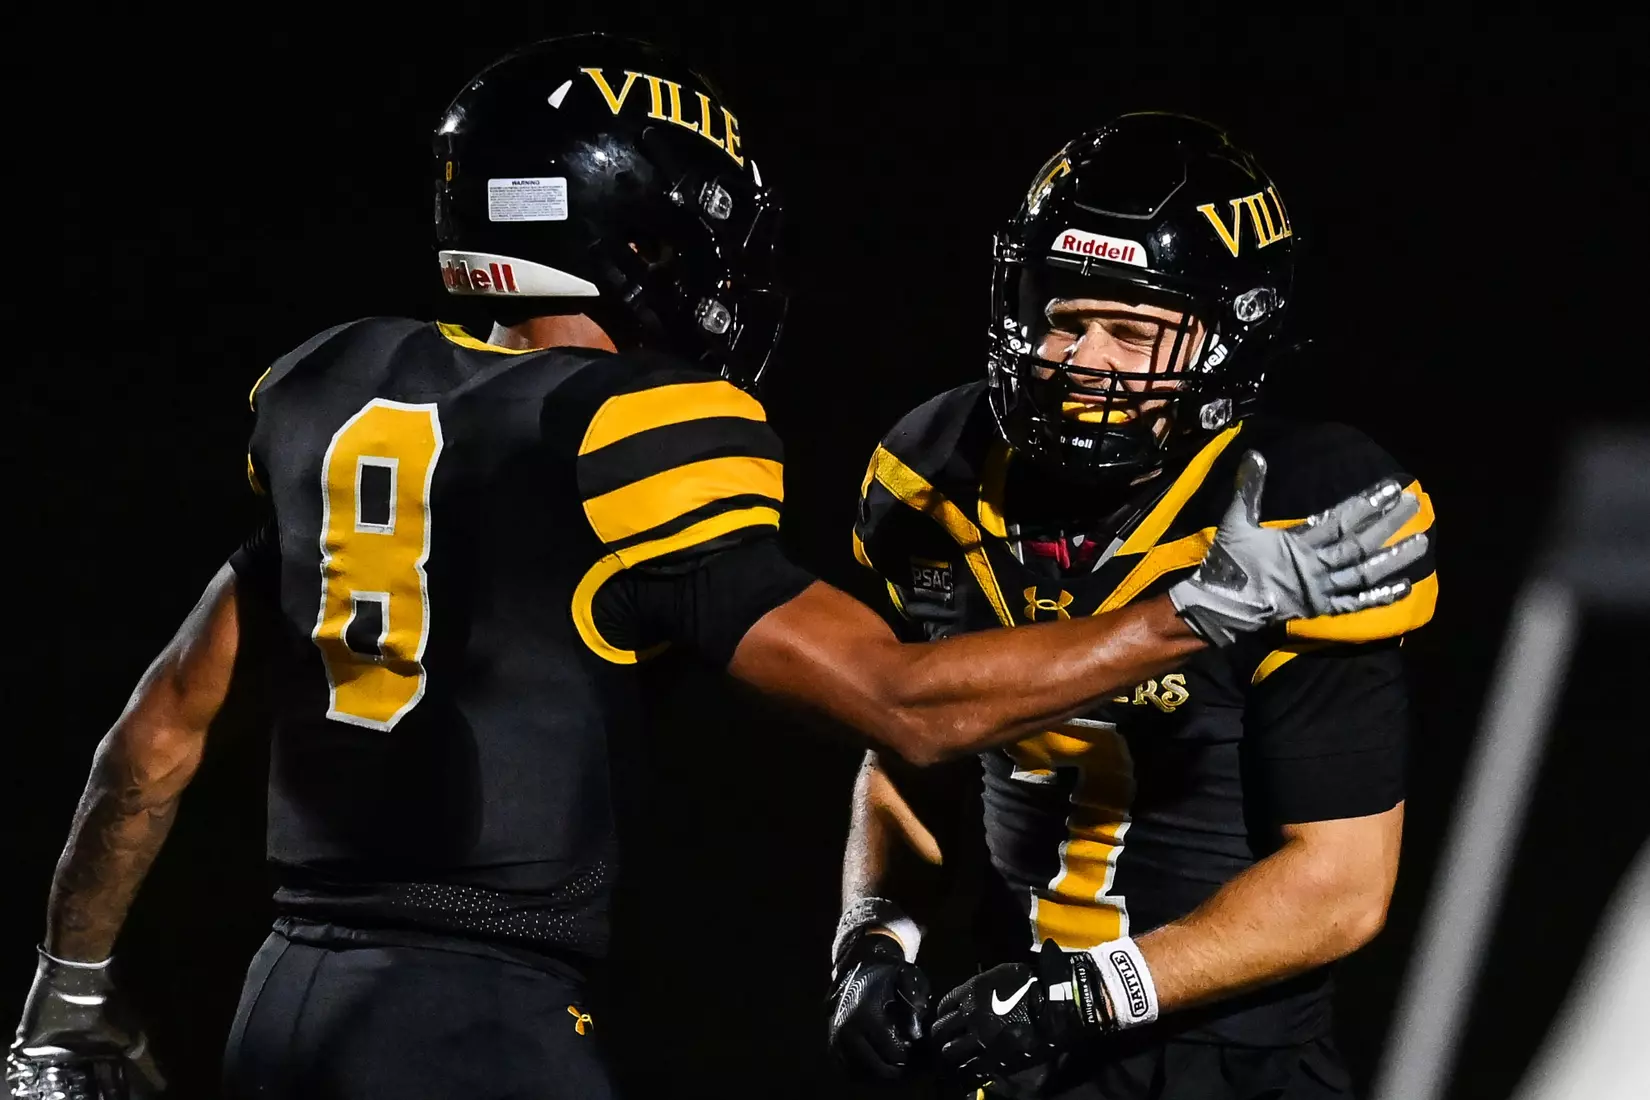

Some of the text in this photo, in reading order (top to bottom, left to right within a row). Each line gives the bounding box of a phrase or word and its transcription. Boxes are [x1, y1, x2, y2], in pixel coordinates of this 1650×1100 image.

[580, 67, 744, 168] VILLE
[1062, 235, 1136, 262] Riddell
[312, 397, 444, 733] 8
[913, 569, 951, 590] PSAC
[1114, 955, 1145, 1013] BATTLE
